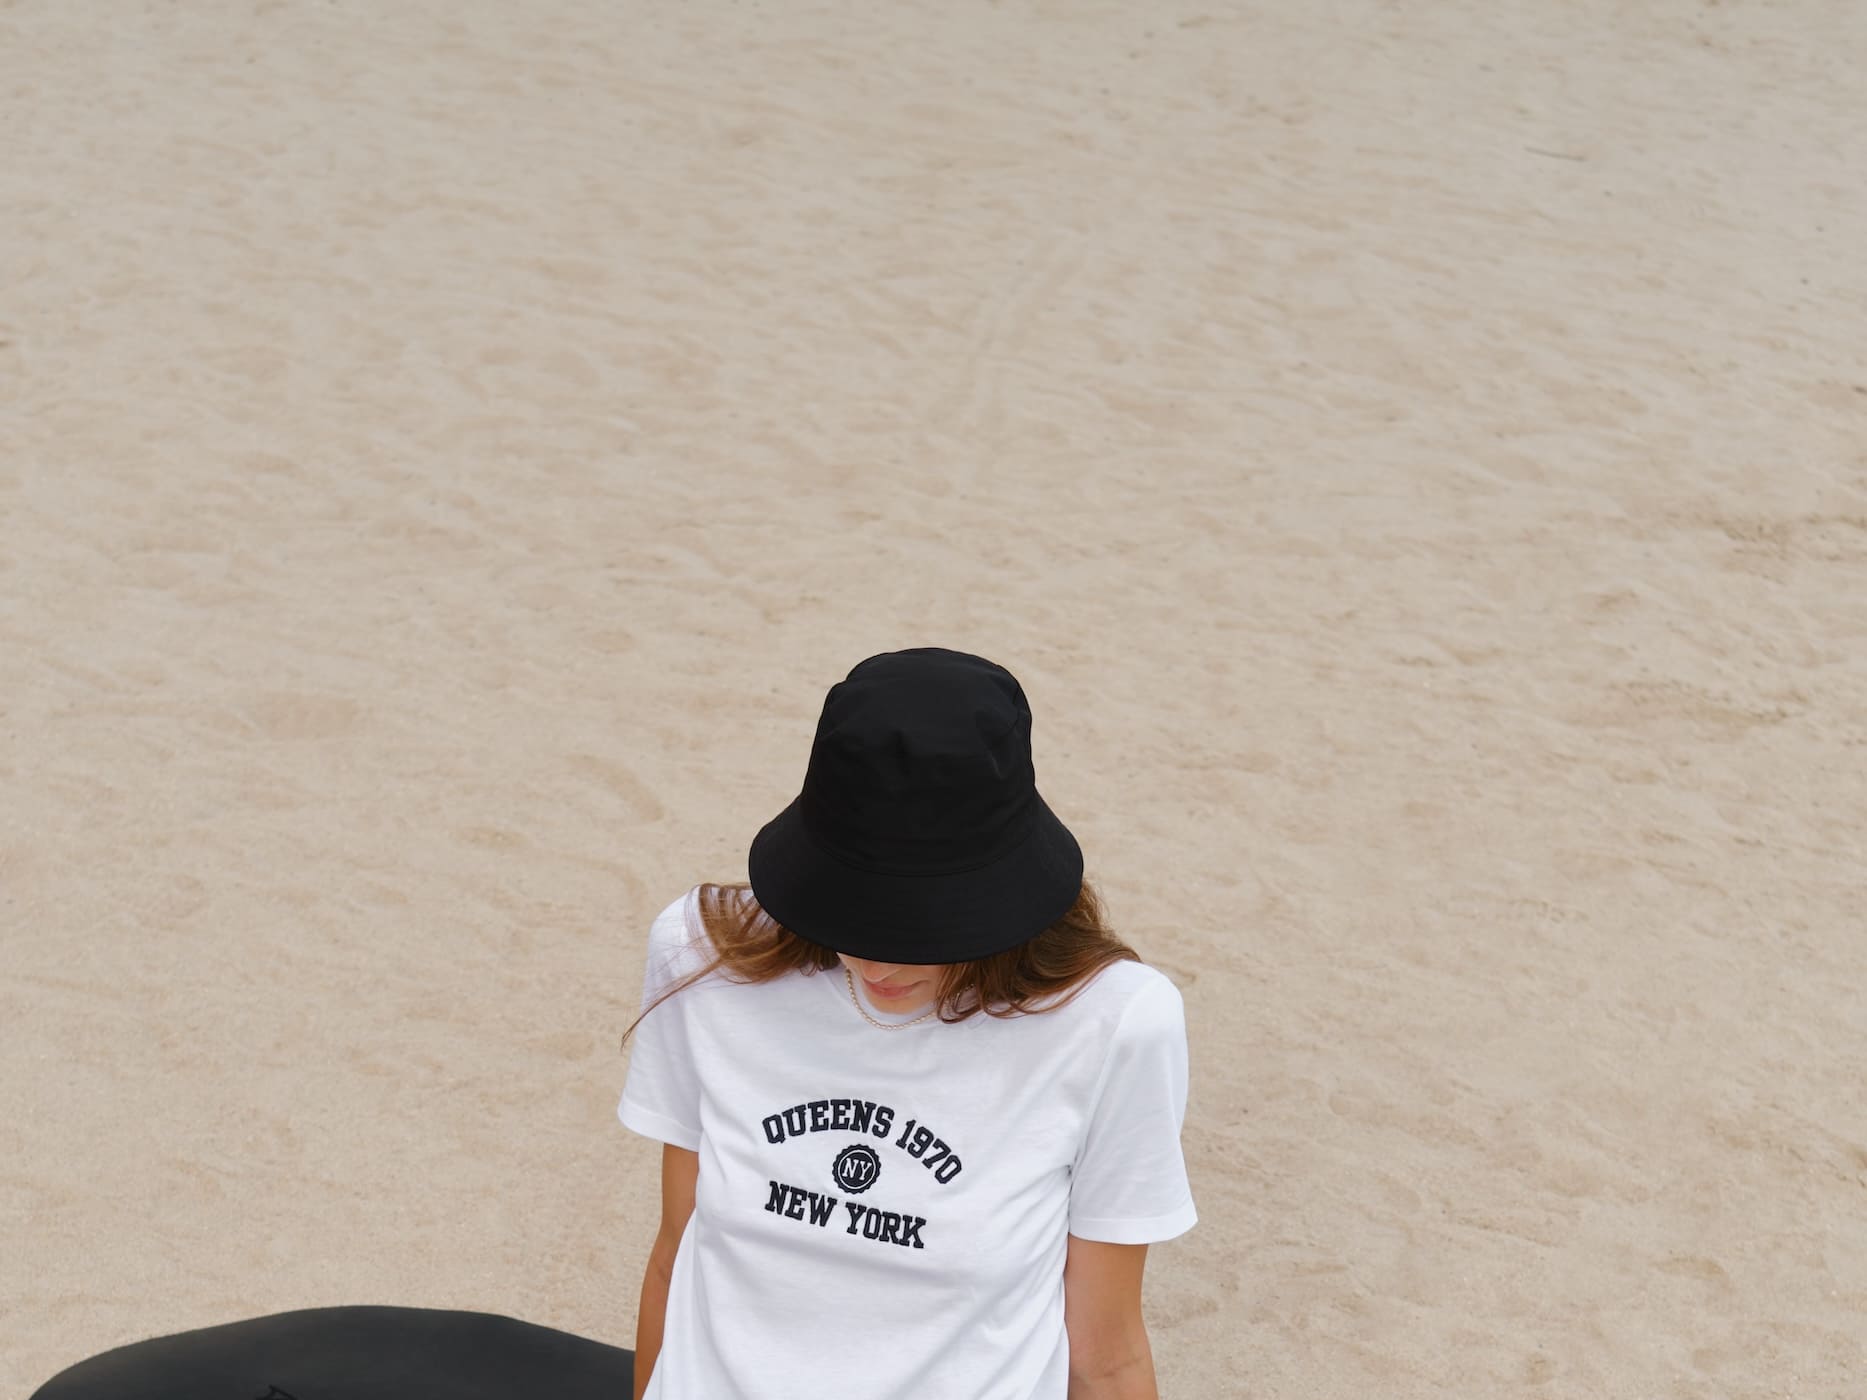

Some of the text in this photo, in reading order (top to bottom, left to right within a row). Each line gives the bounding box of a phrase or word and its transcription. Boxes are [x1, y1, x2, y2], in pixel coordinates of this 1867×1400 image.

[762, 1099, 962, 1184] QUEENS 1970
[842, 1157, 873, 1181] NY
[765, 1181, 927, 1249] NEW YORK
